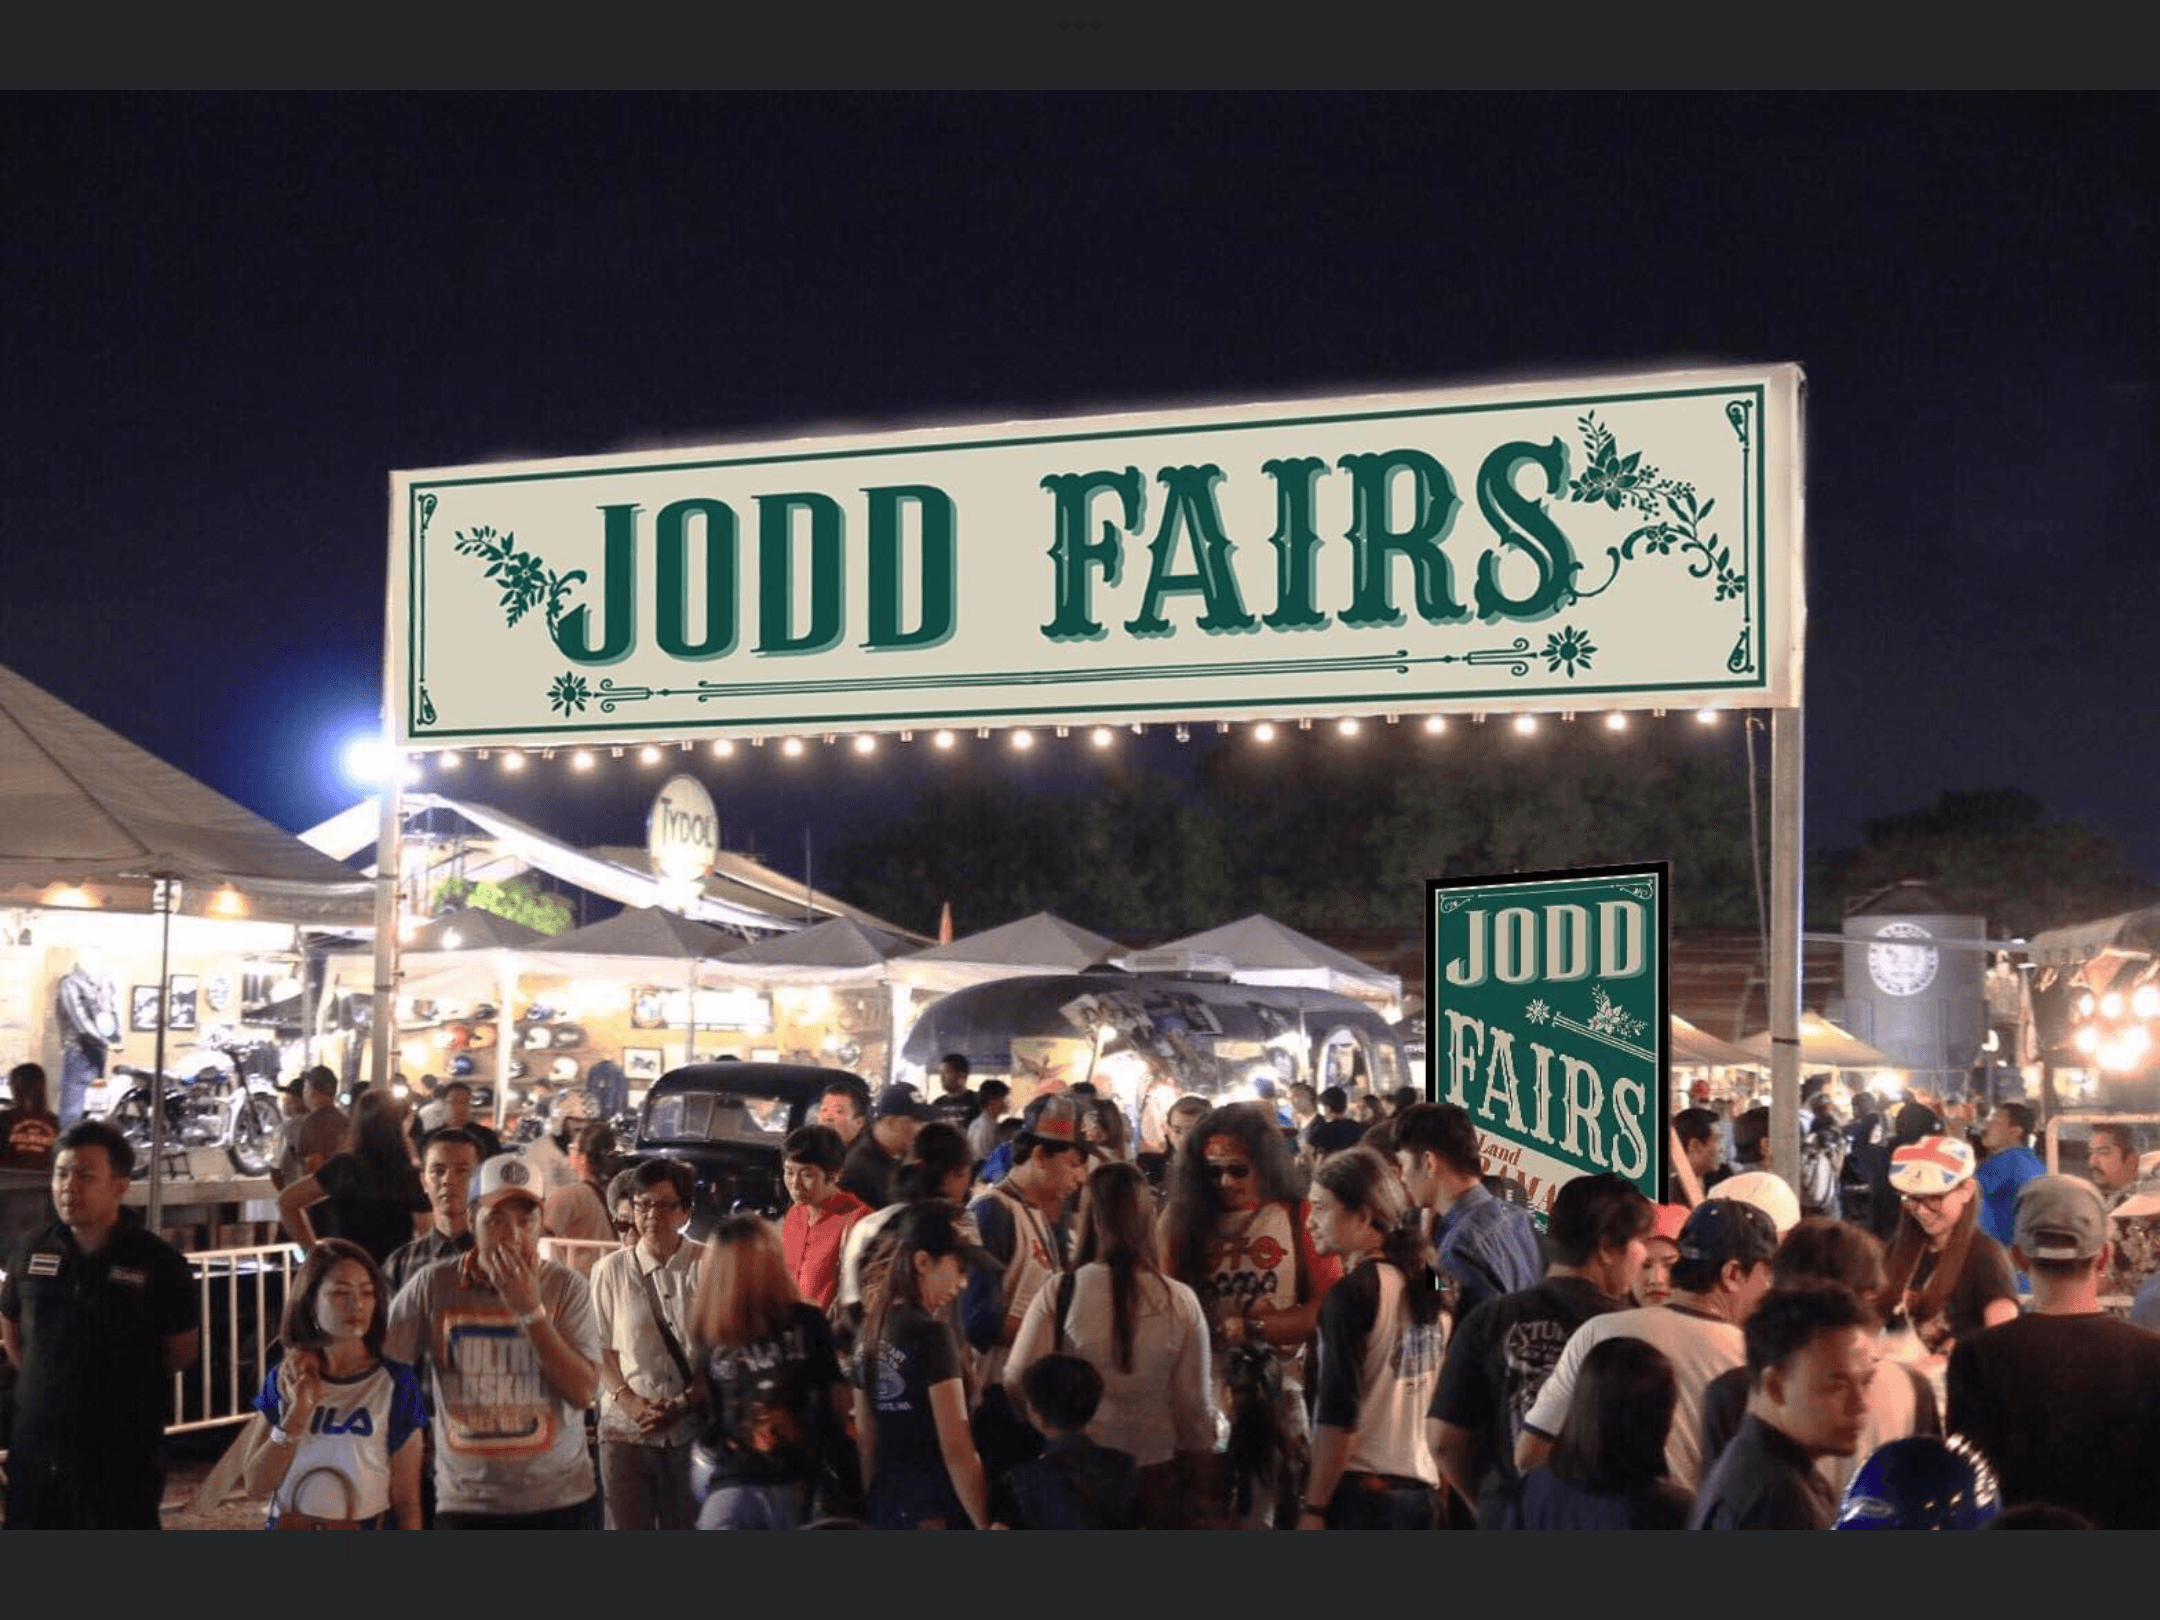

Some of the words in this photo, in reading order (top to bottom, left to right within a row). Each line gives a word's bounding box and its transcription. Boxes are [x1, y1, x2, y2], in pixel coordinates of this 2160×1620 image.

[551, 484, 958, 667] JODD
[1040, 436, 1580, 642] FAIRS
[1445, 900, 1648, 988] JODD
[1445, 1008, 1649, 1181] FAIRS
[1477, 1133, 1522, 1166] Land
